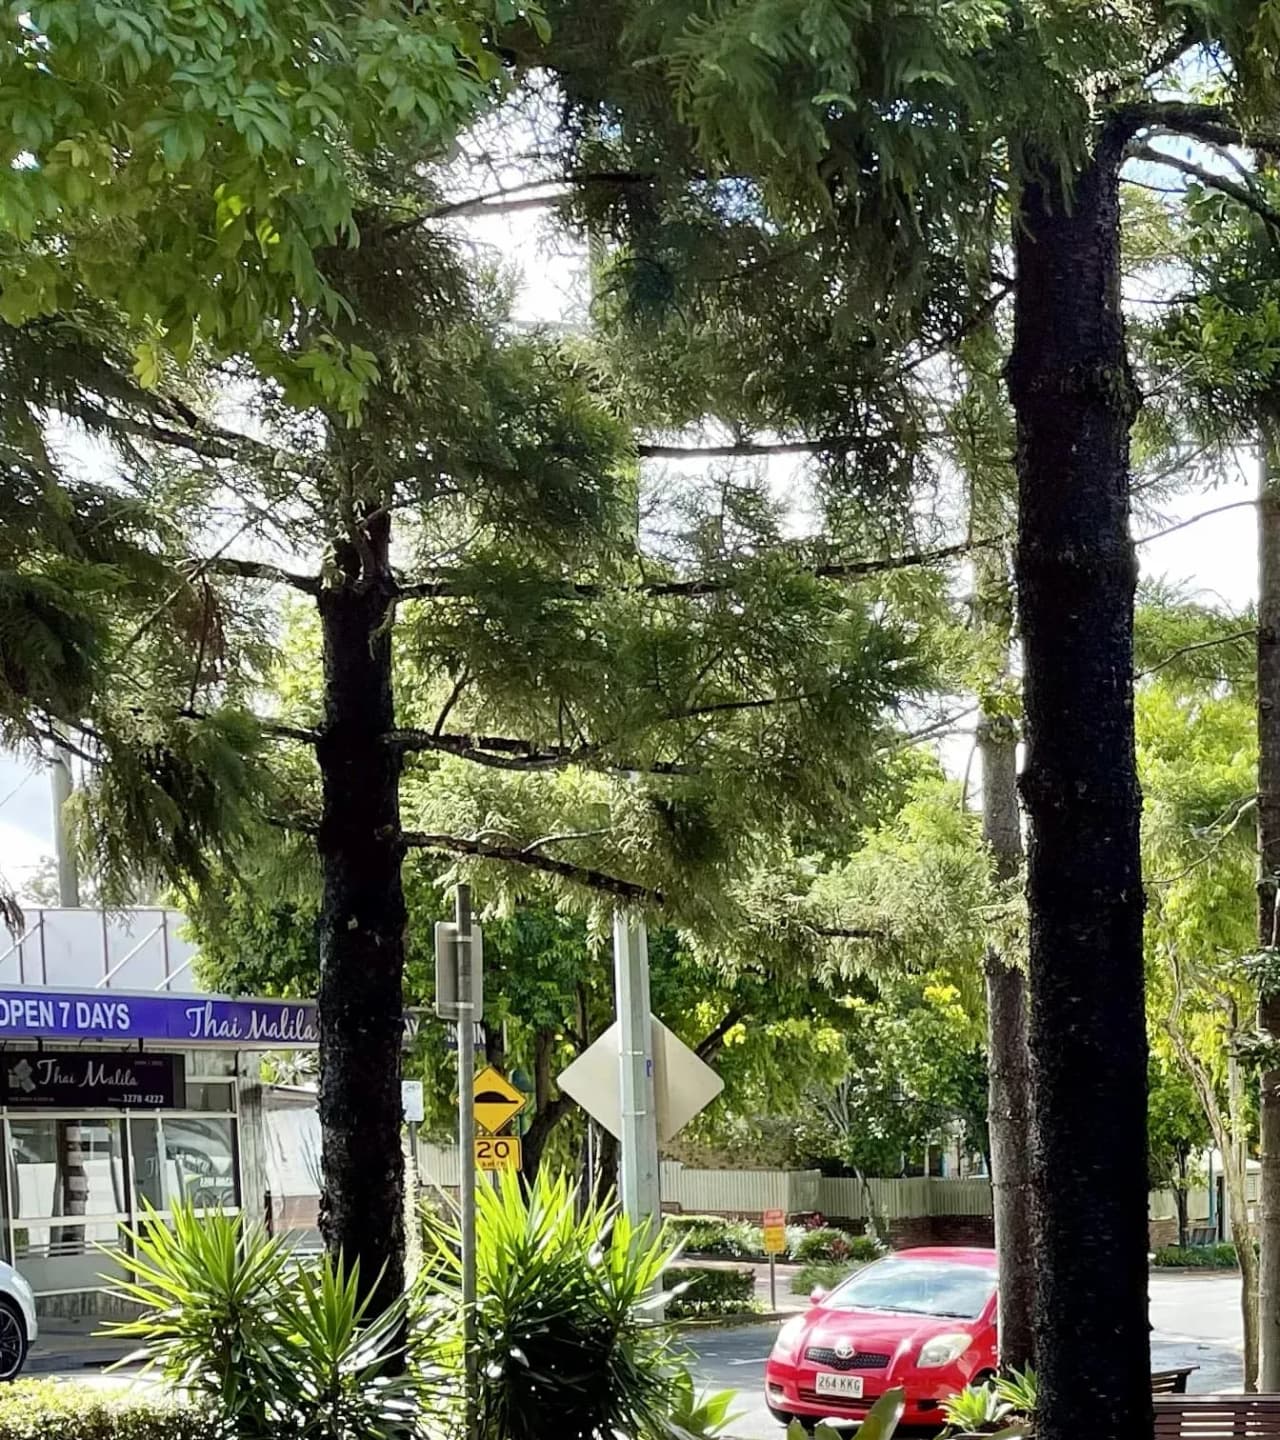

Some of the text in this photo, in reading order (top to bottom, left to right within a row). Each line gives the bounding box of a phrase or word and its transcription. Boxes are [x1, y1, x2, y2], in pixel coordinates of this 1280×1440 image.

[0, 998, 130, 1030] OPEN 7 DAYS
[186, 1001, 318, 1040] Thai Malila
[37, 1058, 138, 1088] Thai Malila
[477, 1142, 510, 1158] 20
